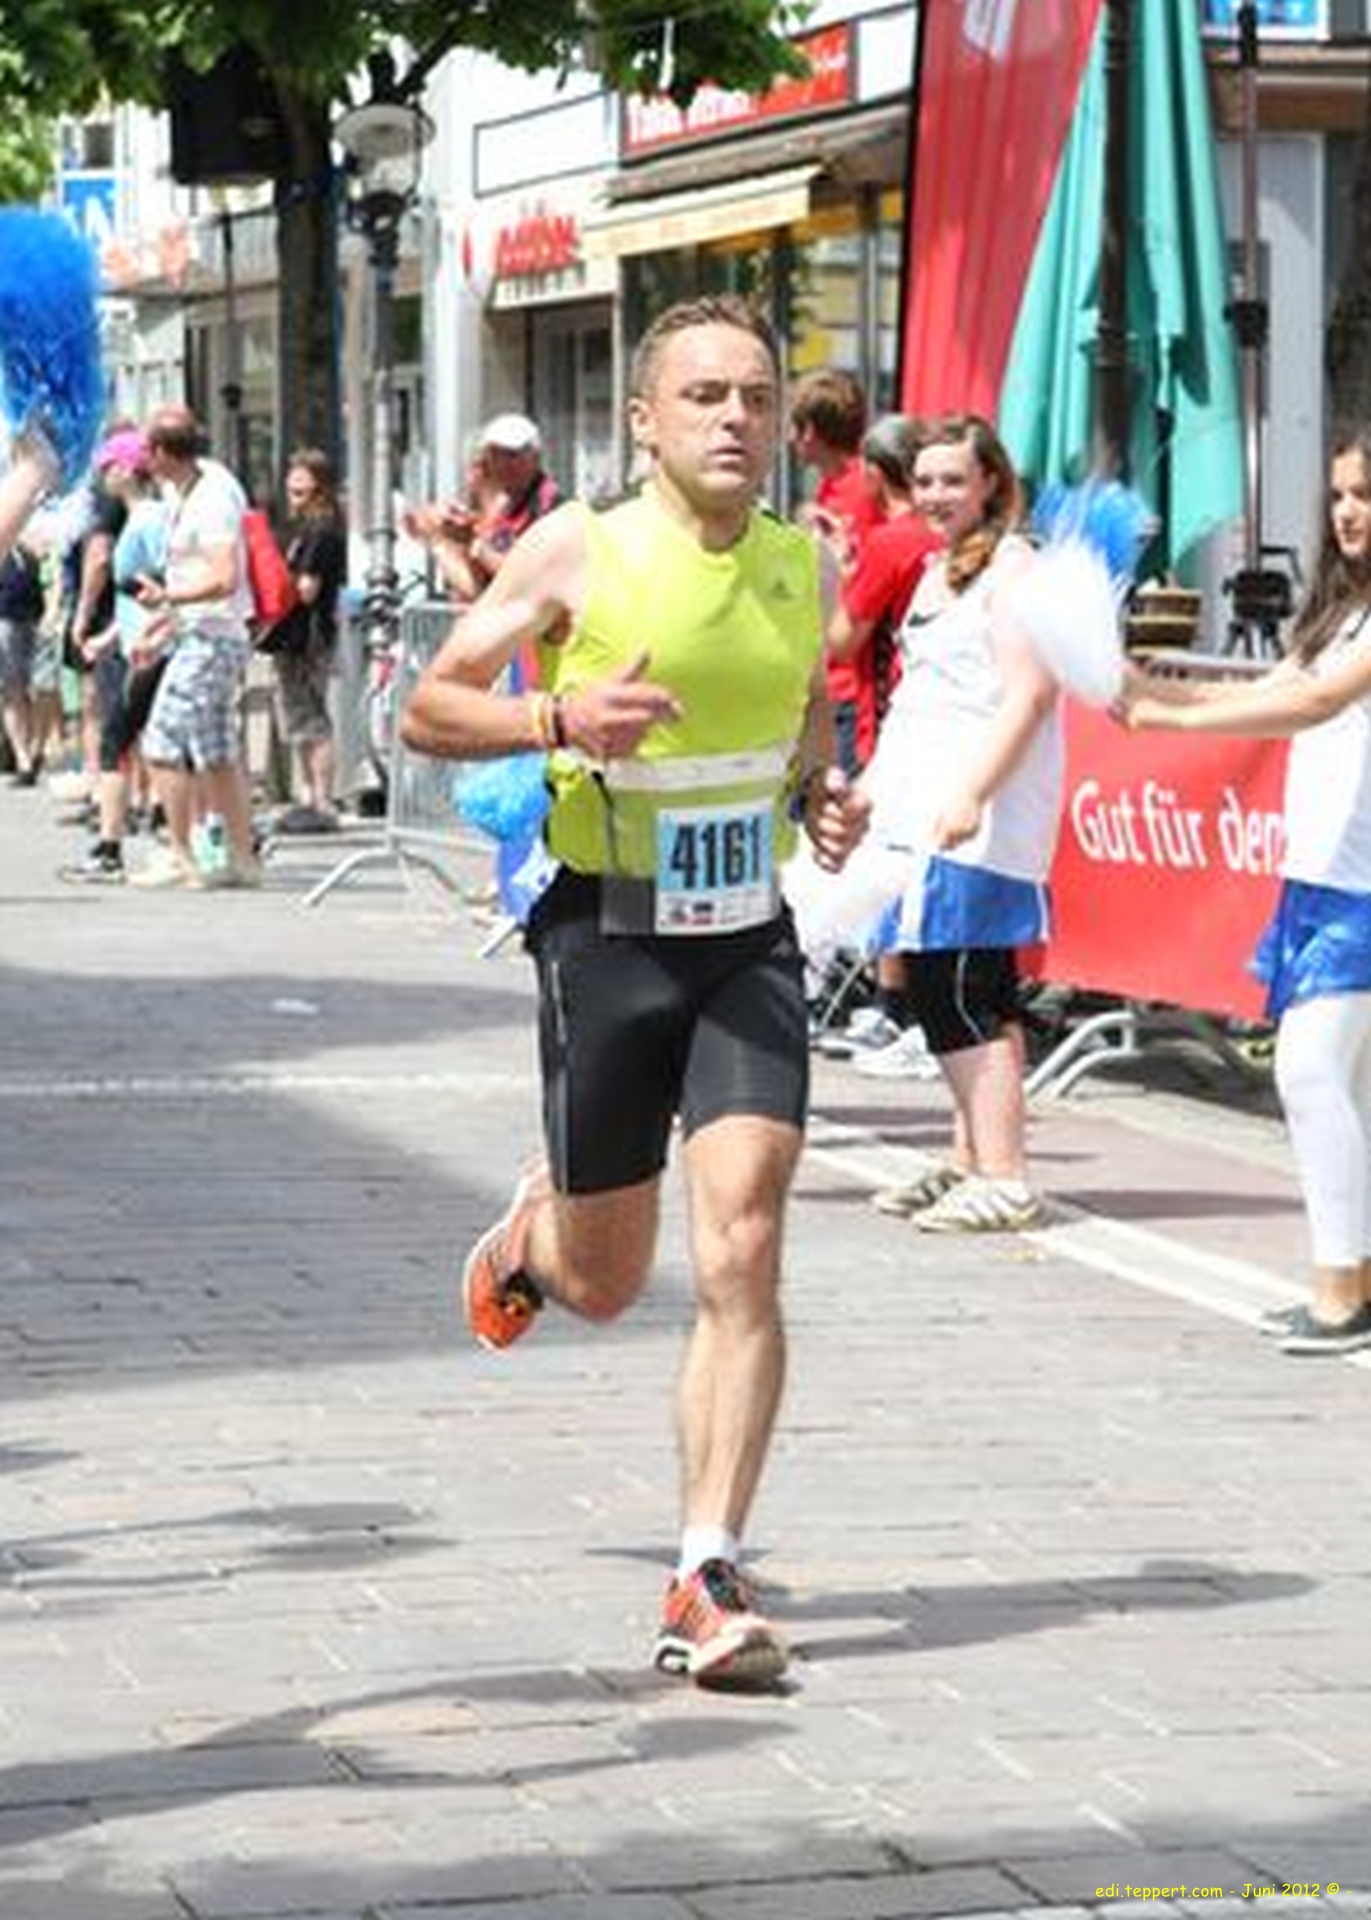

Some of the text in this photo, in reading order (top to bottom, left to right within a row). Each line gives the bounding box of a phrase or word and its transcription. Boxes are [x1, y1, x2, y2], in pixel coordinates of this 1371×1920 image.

[670, 816, 761, 889] 4161
[1072, 780, 1146, 861] Gut
[1144, 781, 1208, 868] für
